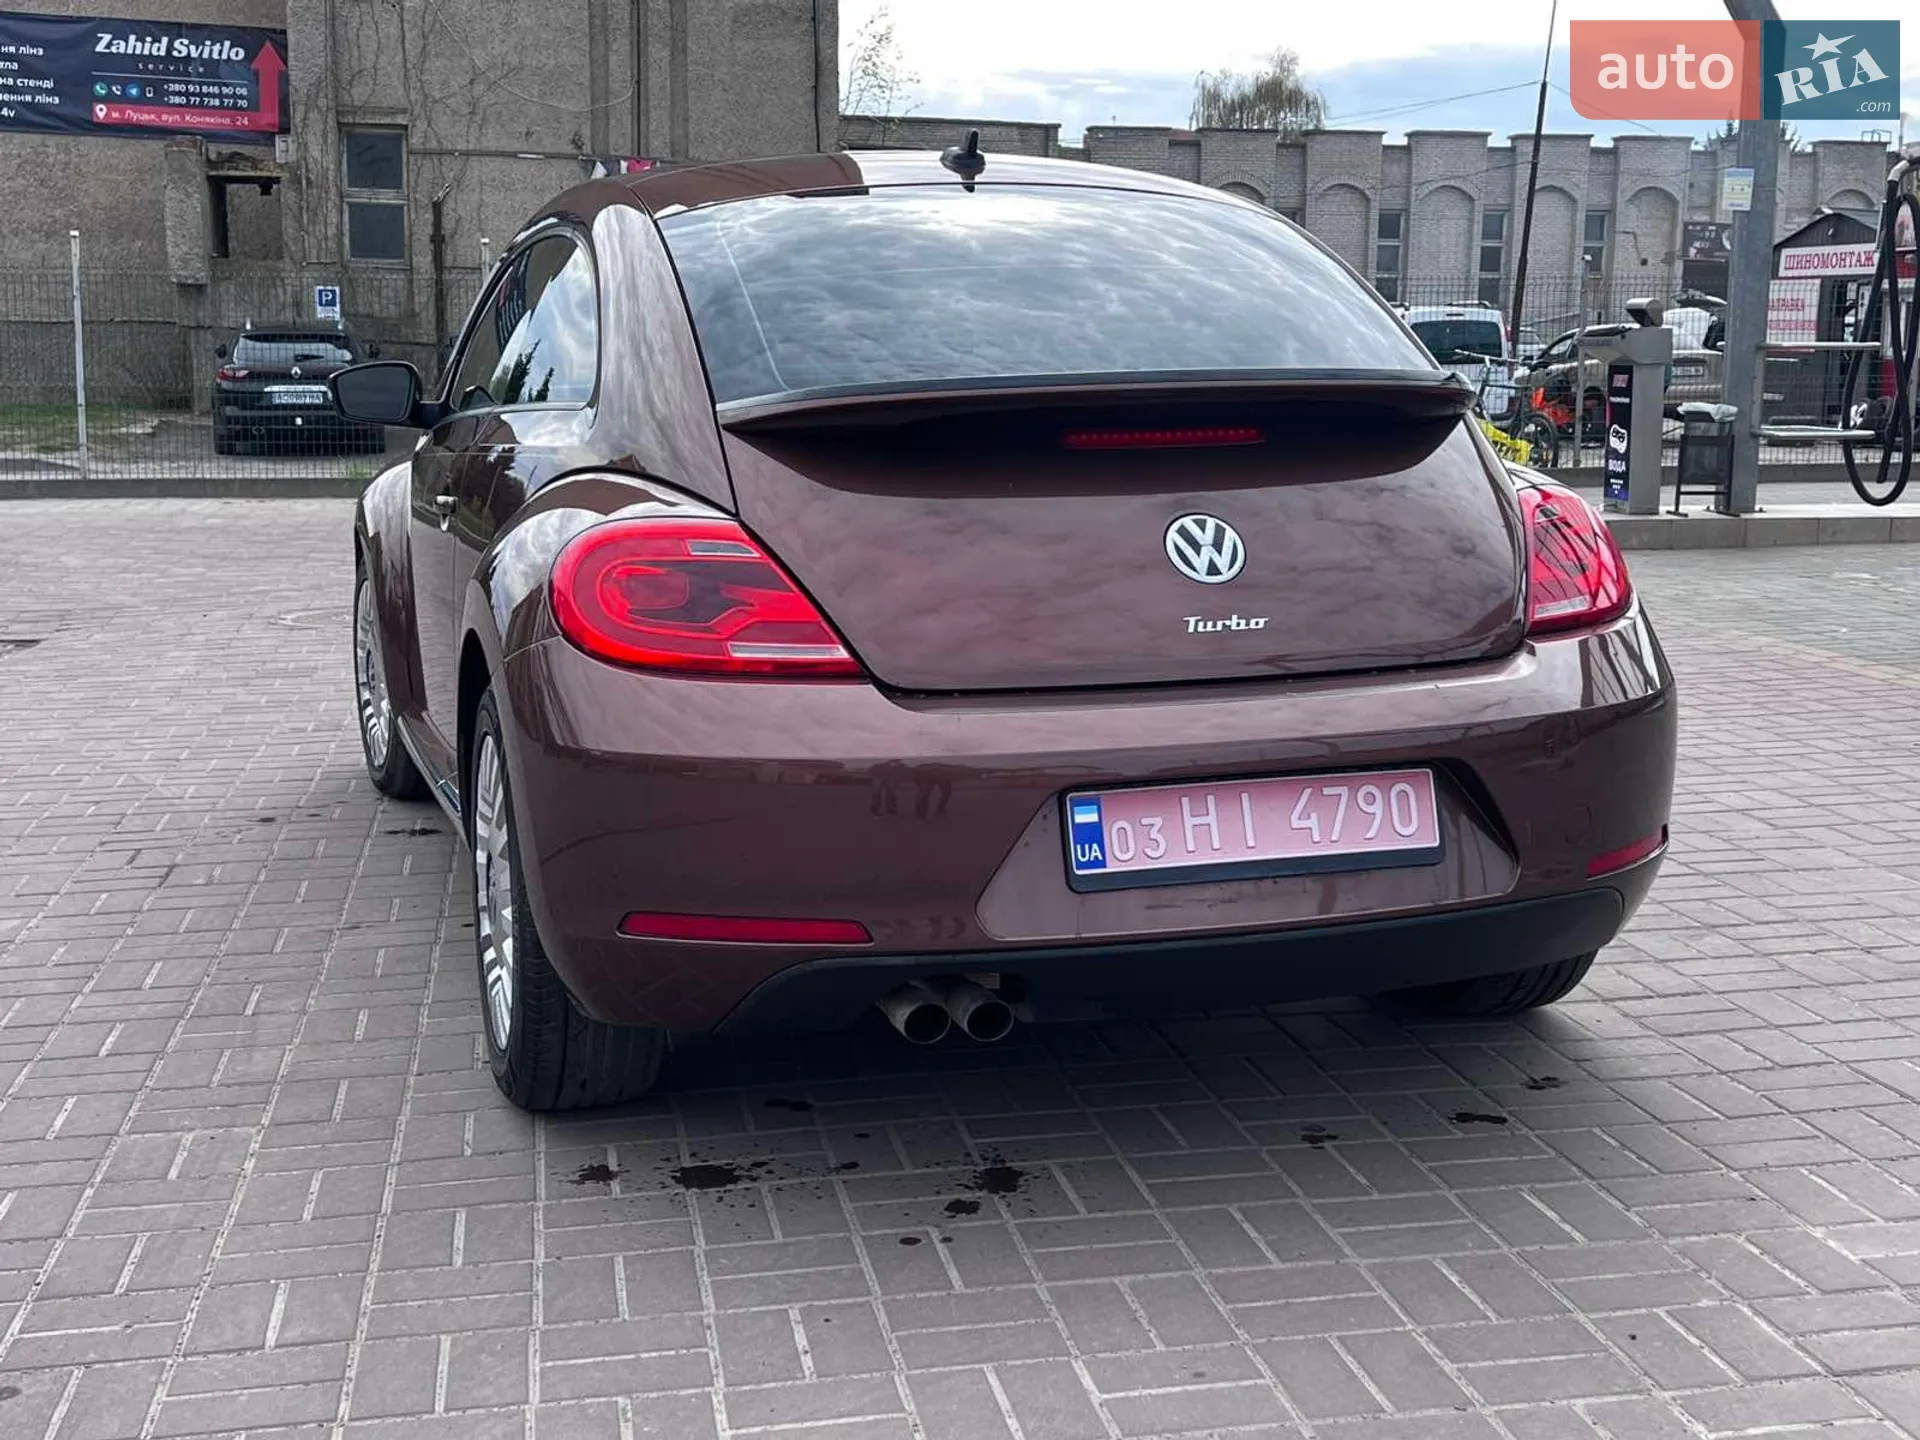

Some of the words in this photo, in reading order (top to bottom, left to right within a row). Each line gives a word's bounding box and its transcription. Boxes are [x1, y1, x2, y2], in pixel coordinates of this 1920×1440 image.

[95, 33, 168, 57] Zahid
[172, 38, 245, 61] Svitlo
[137, 62, 205, 73] service
[16, 77, 54, 89] стенді
[163, 83, 187, 93] +380
[187, 84, 200, 94] 93
[221, 86, 234, 96] 90
[163, 95, 187, 105] +380
[189, 97, 201, 106] 77
[223, 98, 234, 107] 77
[236, 116, 249, 126] 24
[1784, 249, 1876, 271] ШИНОМОНТАЖ
[321, 291, 333, 305] P
[1608, 459, 1626, 473] ВОДА
[1182, 614, 1269, 634] Turbo
[1076, 843, 1103, 863] UA
